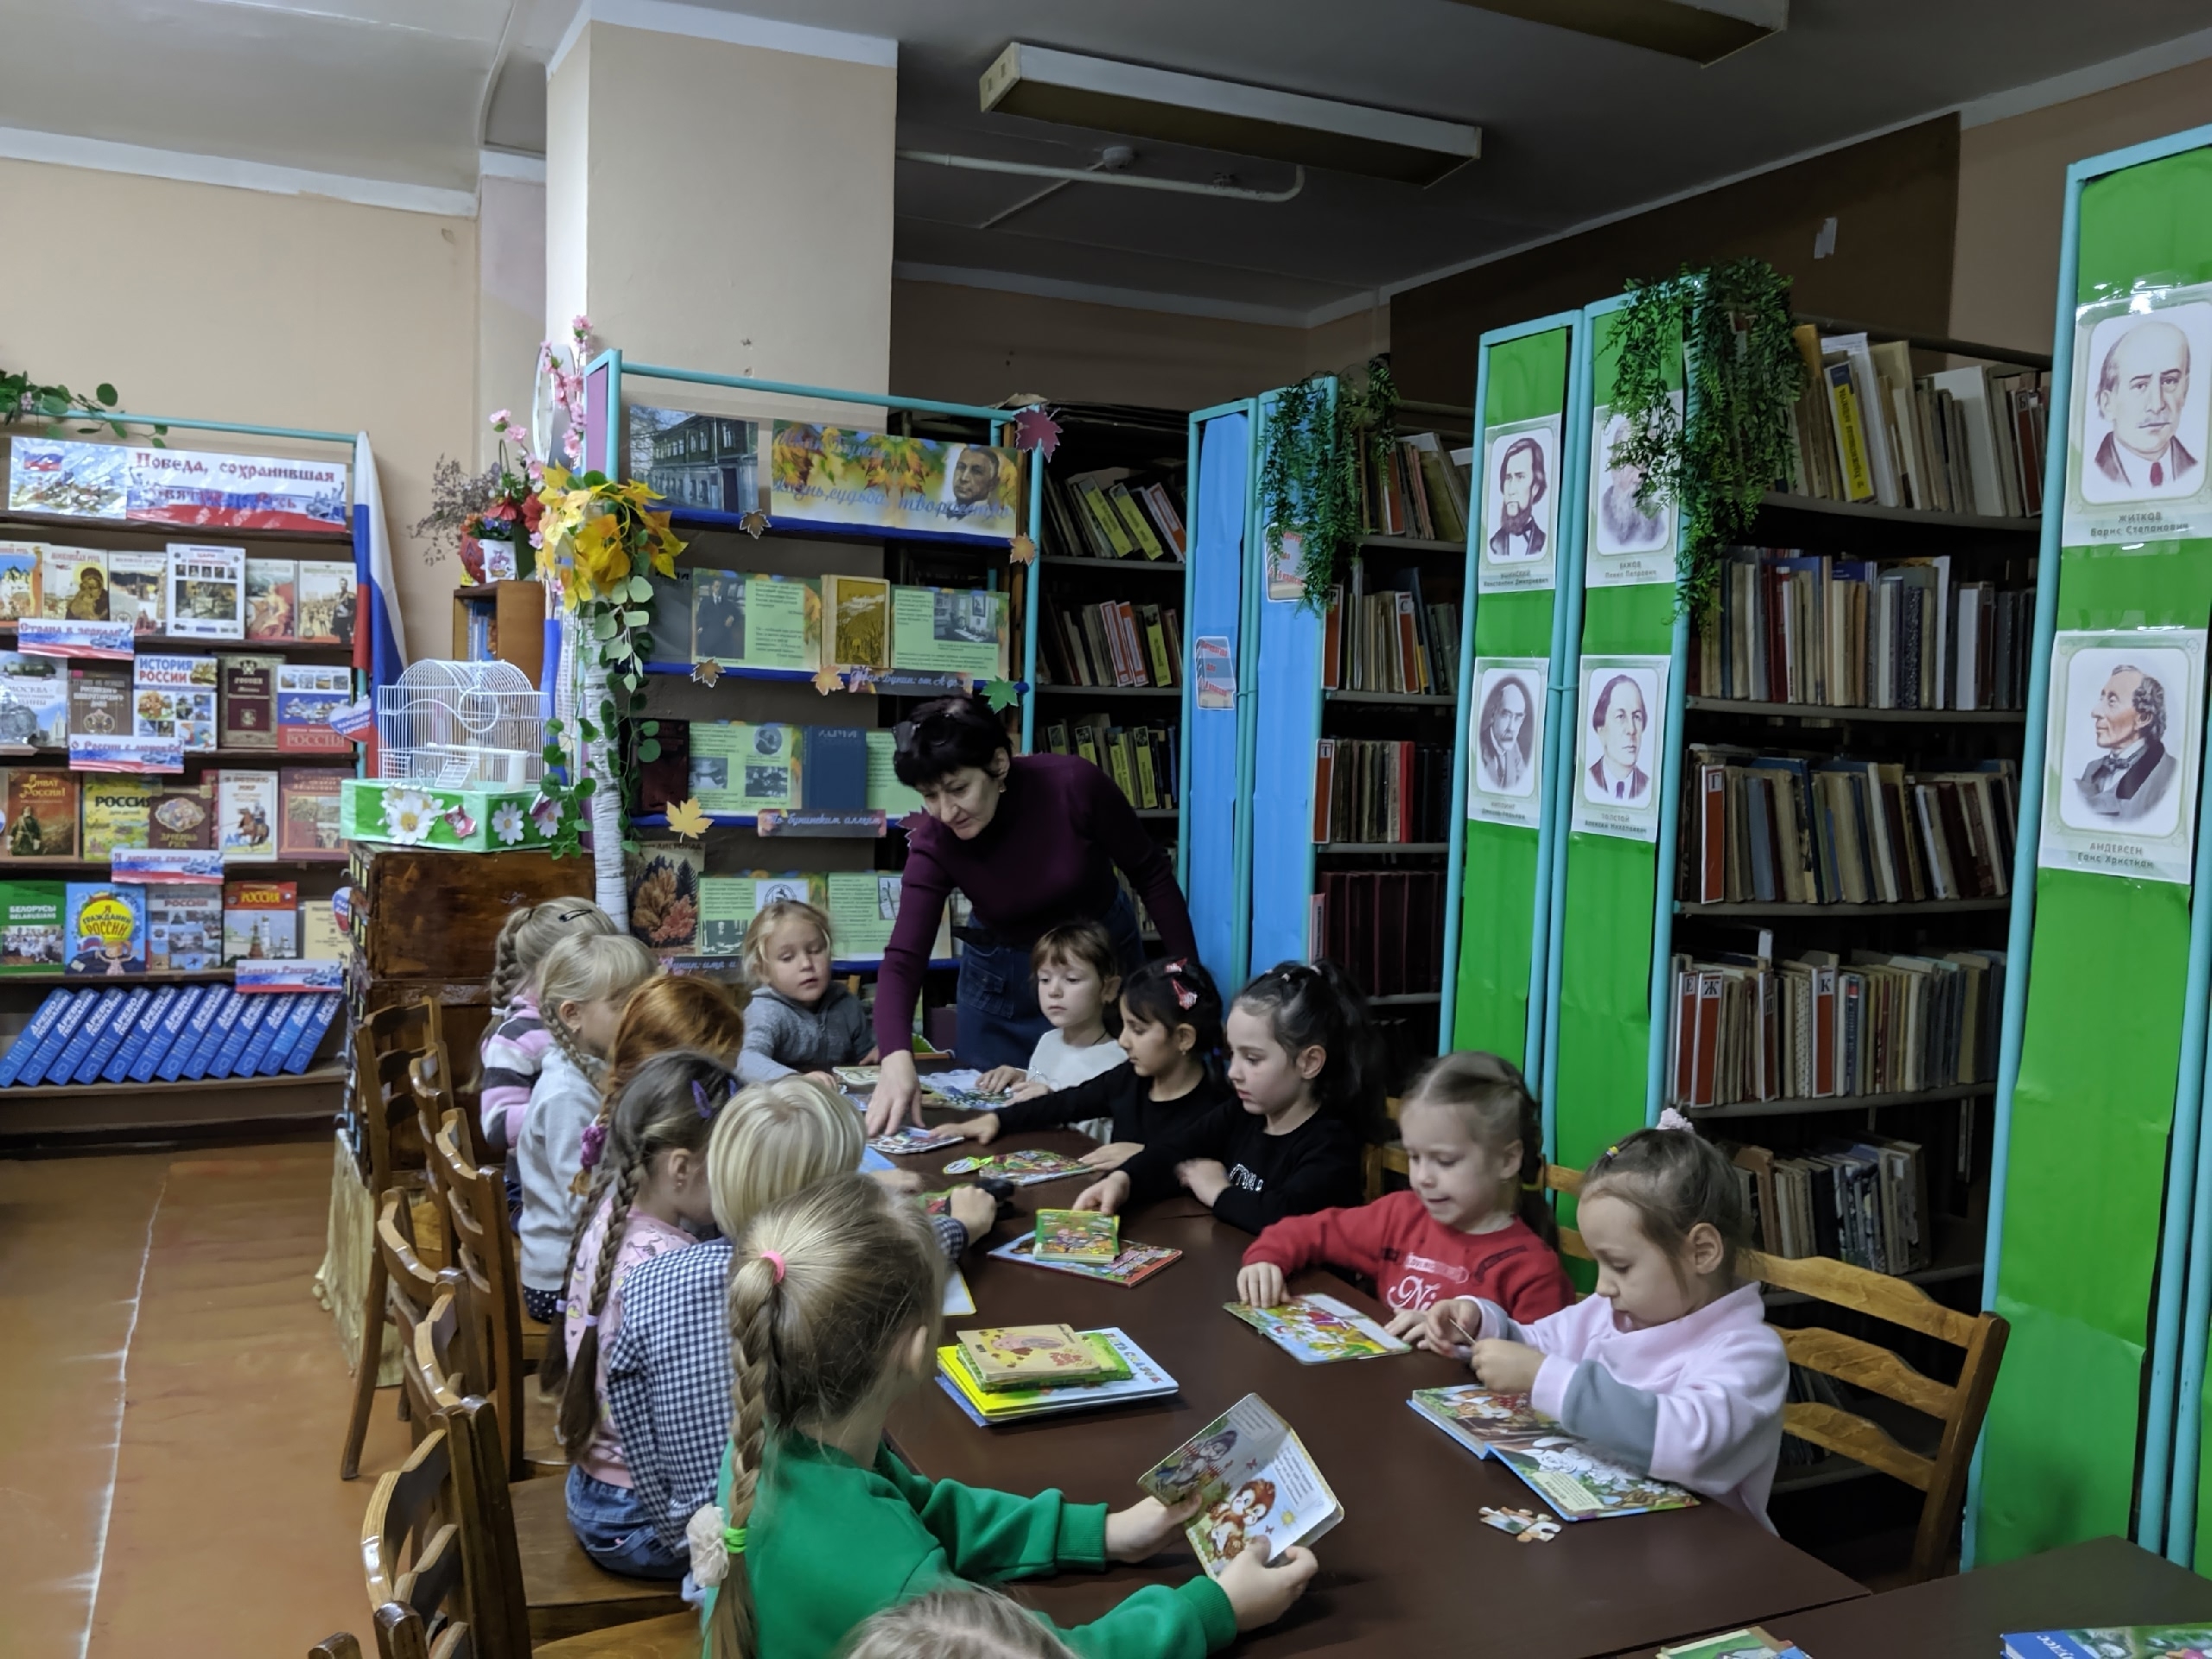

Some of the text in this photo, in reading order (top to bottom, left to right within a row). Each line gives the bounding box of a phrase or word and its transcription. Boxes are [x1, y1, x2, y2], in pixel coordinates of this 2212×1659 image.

[136, 452, 335, 483] Победа, сохранившая
[2119, 512, 2163, 523] ЖИТКОВ
[2090, 522, 2190, 538] Борис Степанович
[1619, 561, 1642, 570] БАЖОВ
[139, 658, 194, 671] ИСТОРИЯ
[139, 671, 187, 683] РОССИИ
[95, 796, 150, 808] РОССИЯ
[1601, 812, 1630, 823] ТОЛСТОЙ
[2089, 842, 2143, 855] АНДЕРСЕН
[2077, 852, 2154, 869] Ганс Христиан
[105, 905, 112, 913] Я
[83, 914, 132, 924] ГРАЖДАНИН
[86, 921, 129, 937] РОССИИ
[1703, 980, 1719, 995] Ж
[1821, 978, 1831, 992] К
